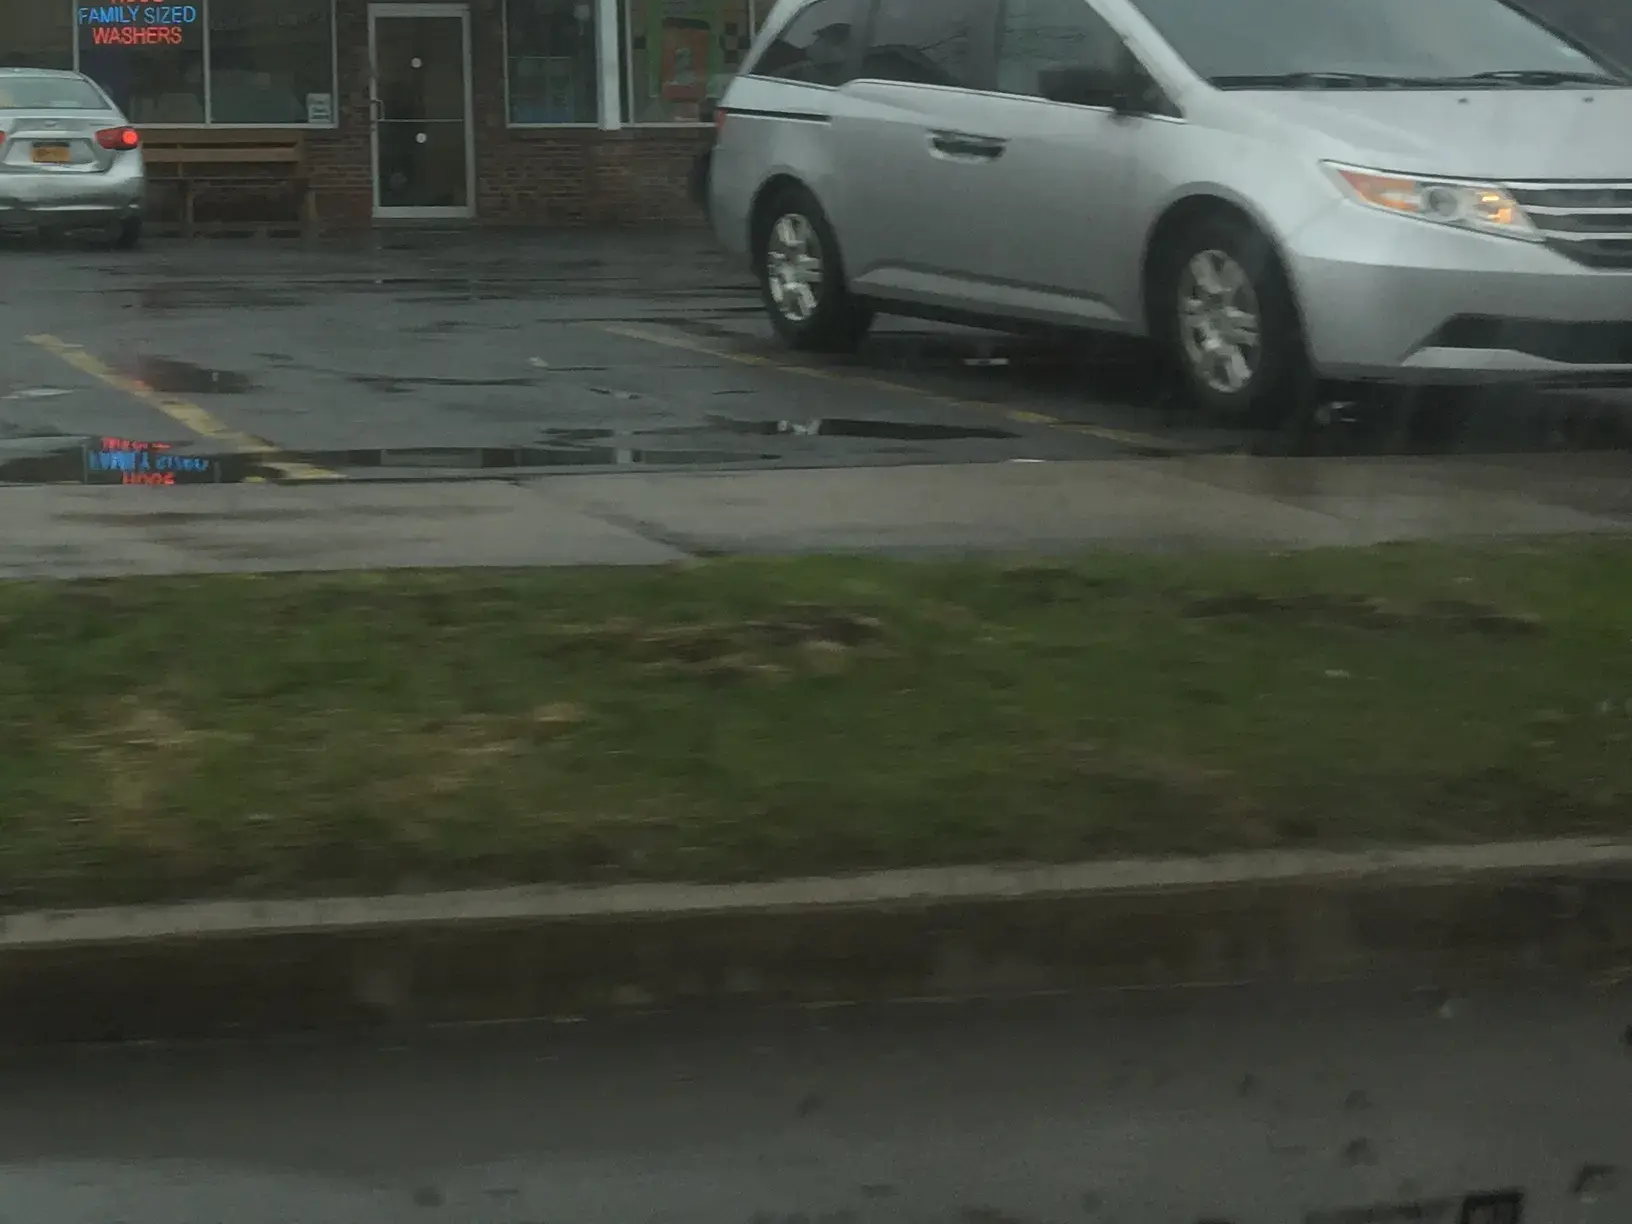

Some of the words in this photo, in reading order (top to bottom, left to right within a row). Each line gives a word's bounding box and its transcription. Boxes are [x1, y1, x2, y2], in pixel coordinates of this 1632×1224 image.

[78, 5, 138, 24] FAMILY
[144, 5, 196, 23] SIZED
[92, 26, 183, 44] WASHERS
